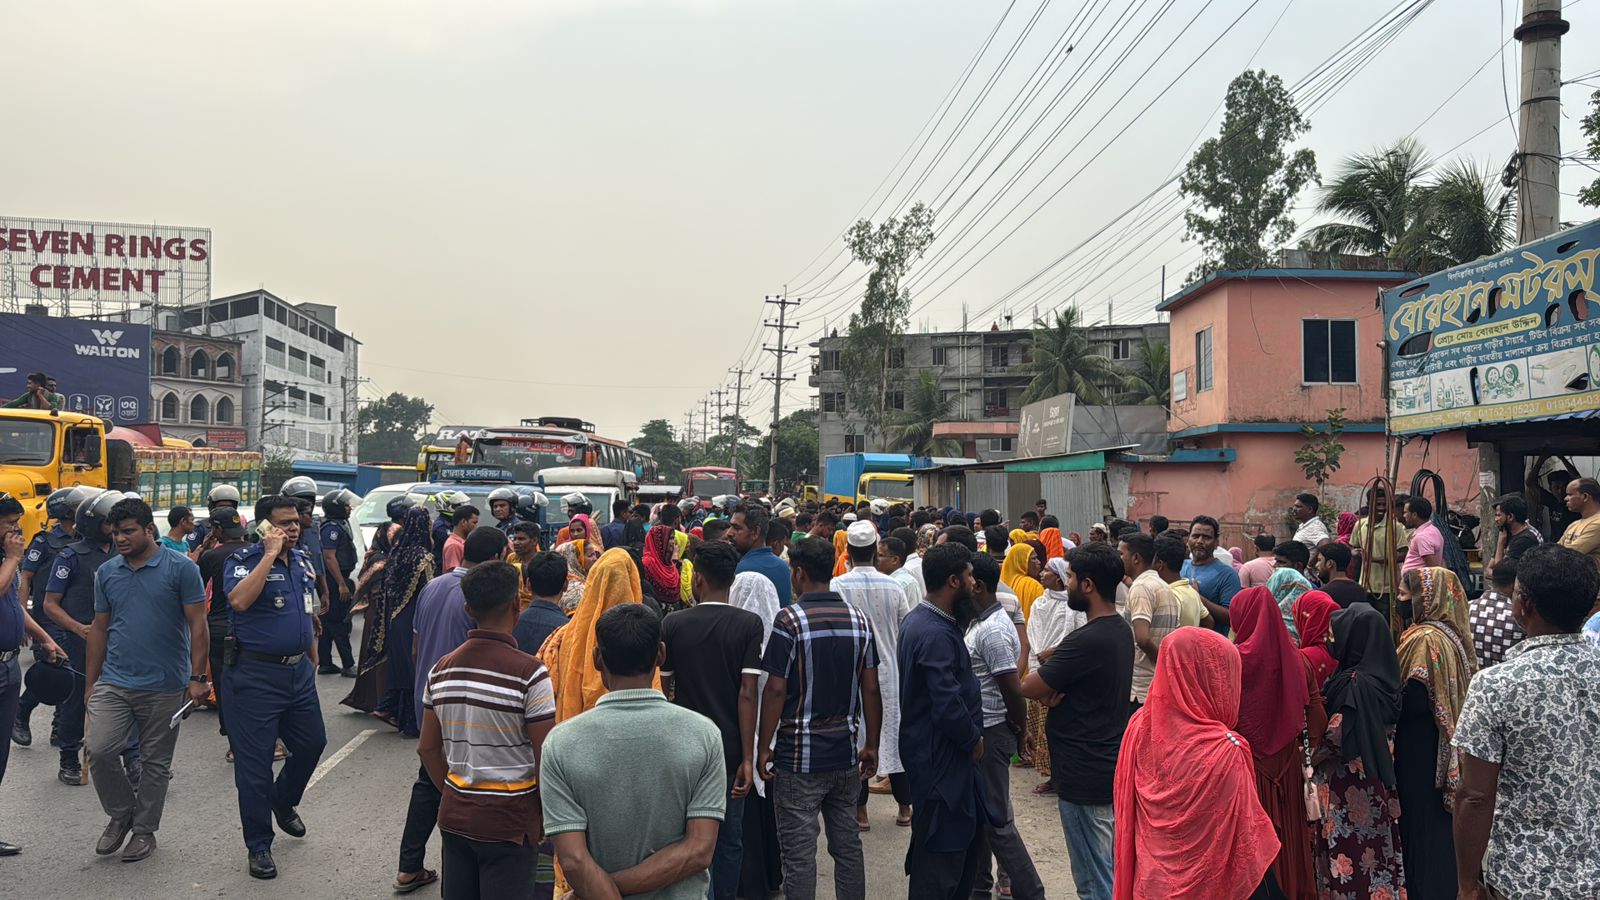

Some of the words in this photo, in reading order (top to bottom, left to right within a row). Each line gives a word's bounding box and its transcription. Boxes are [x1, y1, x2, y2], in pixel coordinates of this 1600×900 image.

[105, 234, 208, 261] RINGS
[30, 264, 166, 293] CEMENT
[1389, 280, 1494, 340] বোরহান
[1476, 322, 1509, 337] বোরহান
[1511, 315, 1537, 329] উদ্দিন
[74, 344, 140, 359] WALTON
